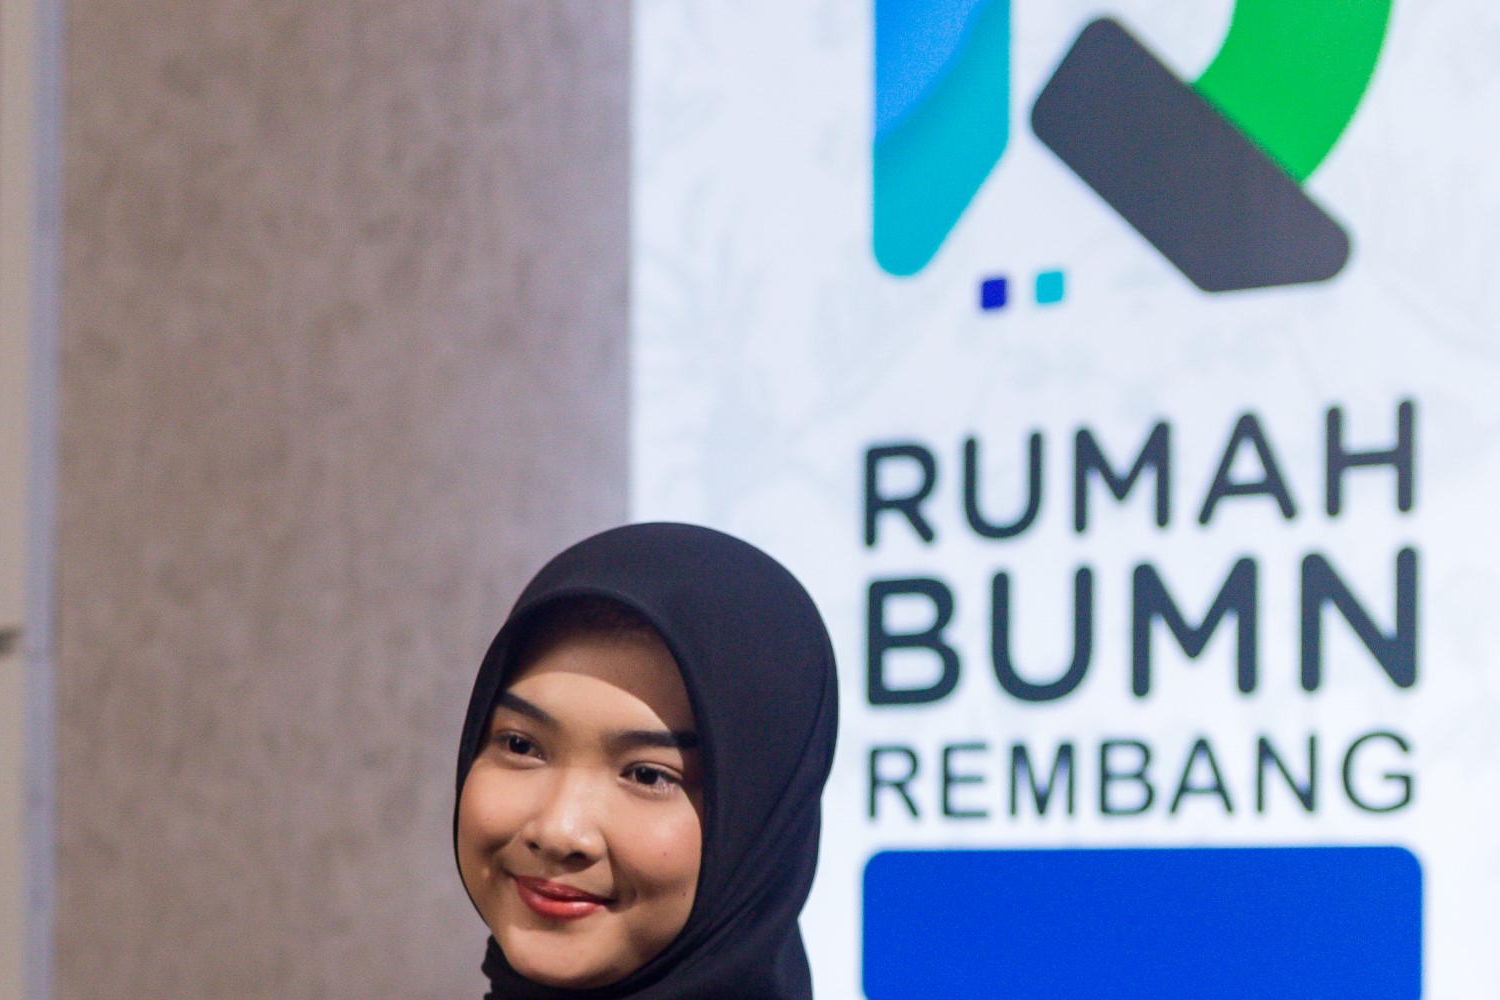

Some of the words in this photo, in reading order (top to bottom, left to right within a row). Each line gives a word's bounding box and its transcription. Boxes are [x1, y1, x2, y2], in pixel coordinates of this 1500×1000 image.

[862, 398, 1416, 550] RUMAH
[863, 545, 1420, 709] BUMN
[866, 730, 1415, 820] REMBANG
